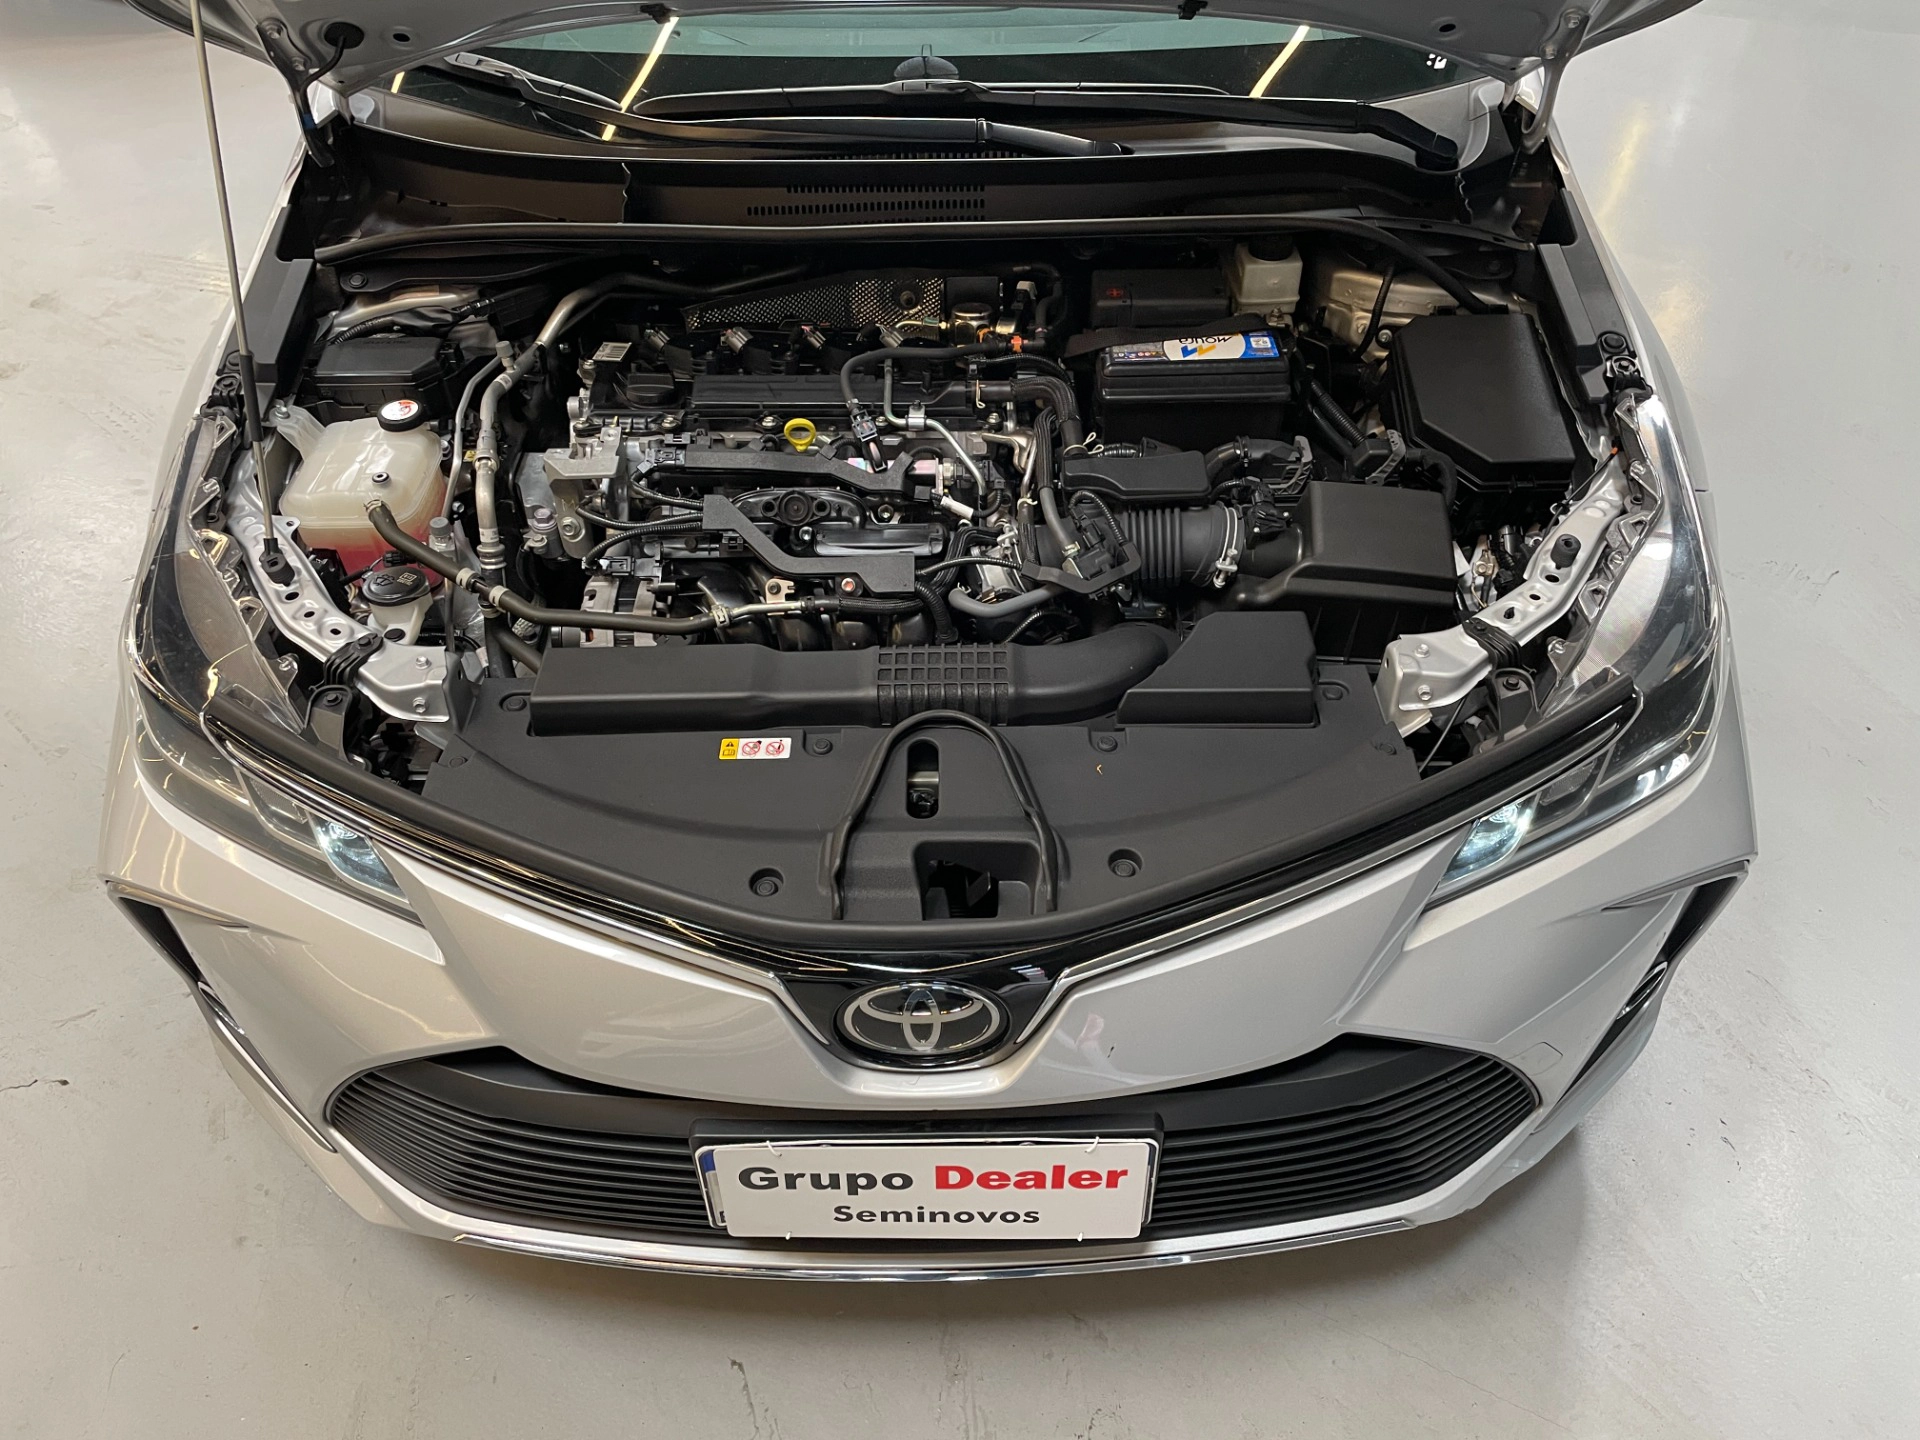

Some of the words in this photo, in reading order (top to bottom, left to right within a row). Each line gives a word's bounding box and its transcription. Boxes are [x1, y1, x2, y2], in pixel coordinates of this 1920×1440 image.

[738, 1166, 914, 1196] Grupo
[935, 1164, 1129, 1190] Dealer
[833, 1205, 1040, 1224] Seminovos
